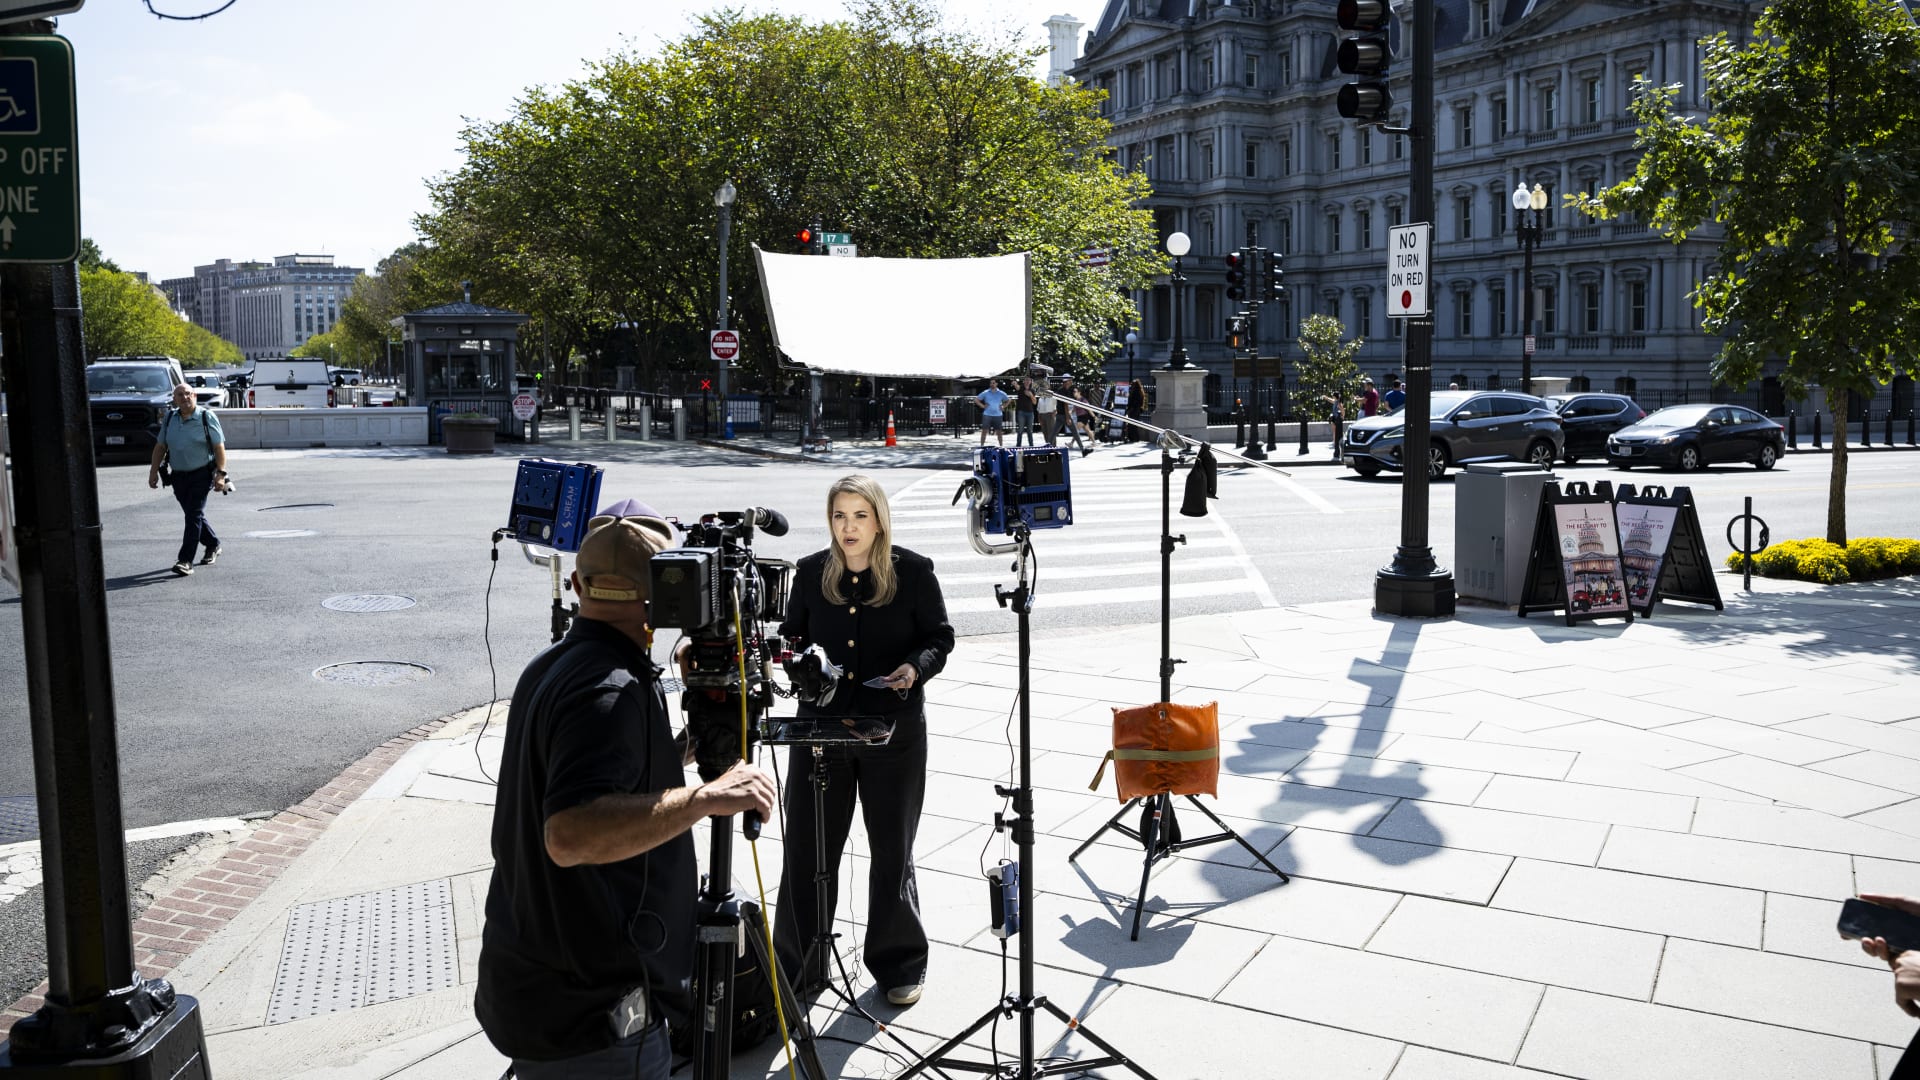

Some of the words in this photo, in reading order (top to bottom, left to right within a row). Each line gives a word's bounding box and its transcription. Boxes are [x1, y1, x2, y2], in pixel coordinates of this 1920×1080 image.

[21, 148, 67, 174] OFF
[0, 186, 39, 213] NE
[827, 234, 837, 243] 17
[1400, 232, 1416, 249] NO
[1396, 253, 1419, 268] TURN
[1391, 273, 1403, 287] ON
[1406, 272, 1423, 286] RED
